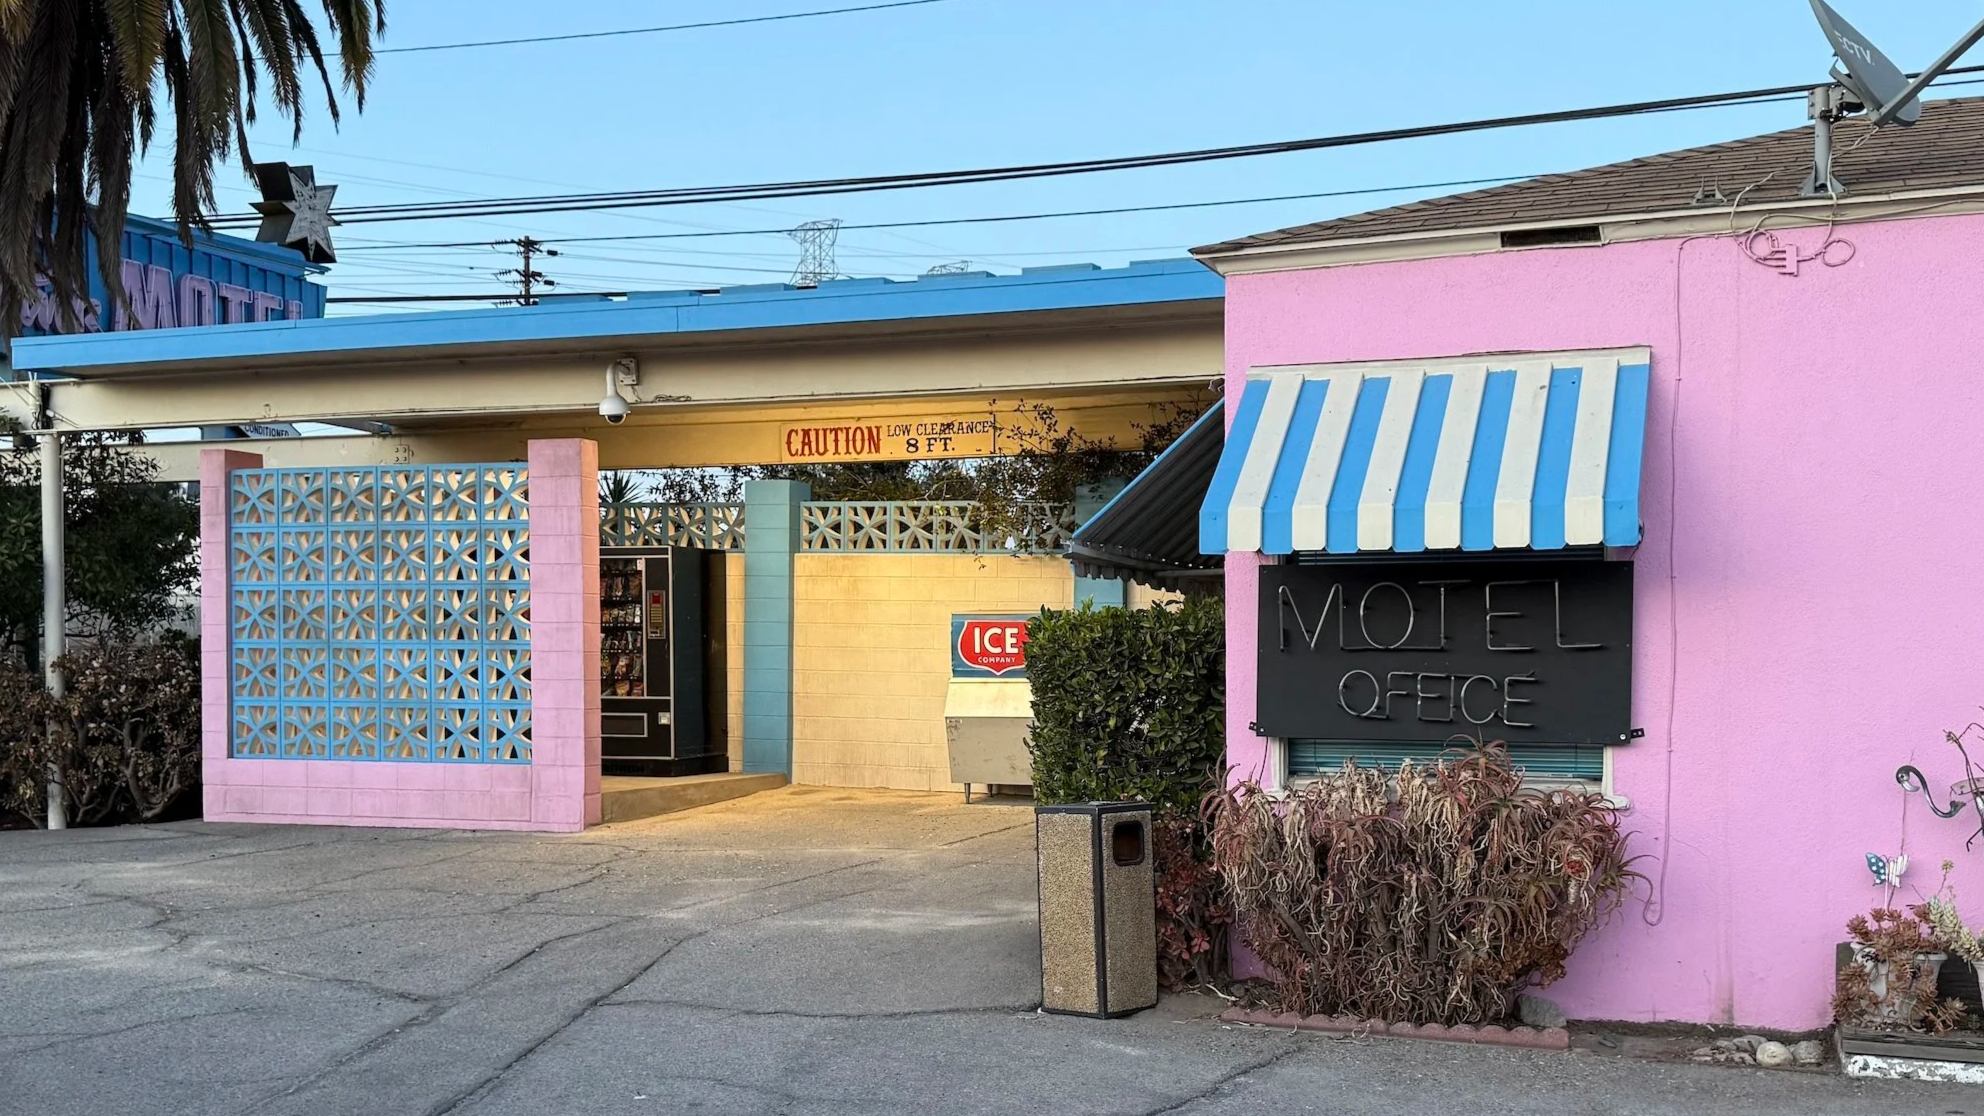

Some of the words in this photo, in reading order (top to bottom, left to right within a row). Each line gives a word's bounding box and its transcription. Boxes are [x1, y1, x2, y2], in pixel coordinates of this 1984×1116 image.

[114, 259, 304, 331] MOT
[786, 426, 882, 456] CAUTION
[887, 424, 912, 437] LOW
[916, 420, 988, 436] CLEARANCE
[906, 438, 919, 453] 8
[926, 437, 955, 453] FT.
[1279, 578, 1604, 652] MOTEL
[974, 626, 1019, 655] ICE
[1337, 669, 1538, 728] OFFICE
